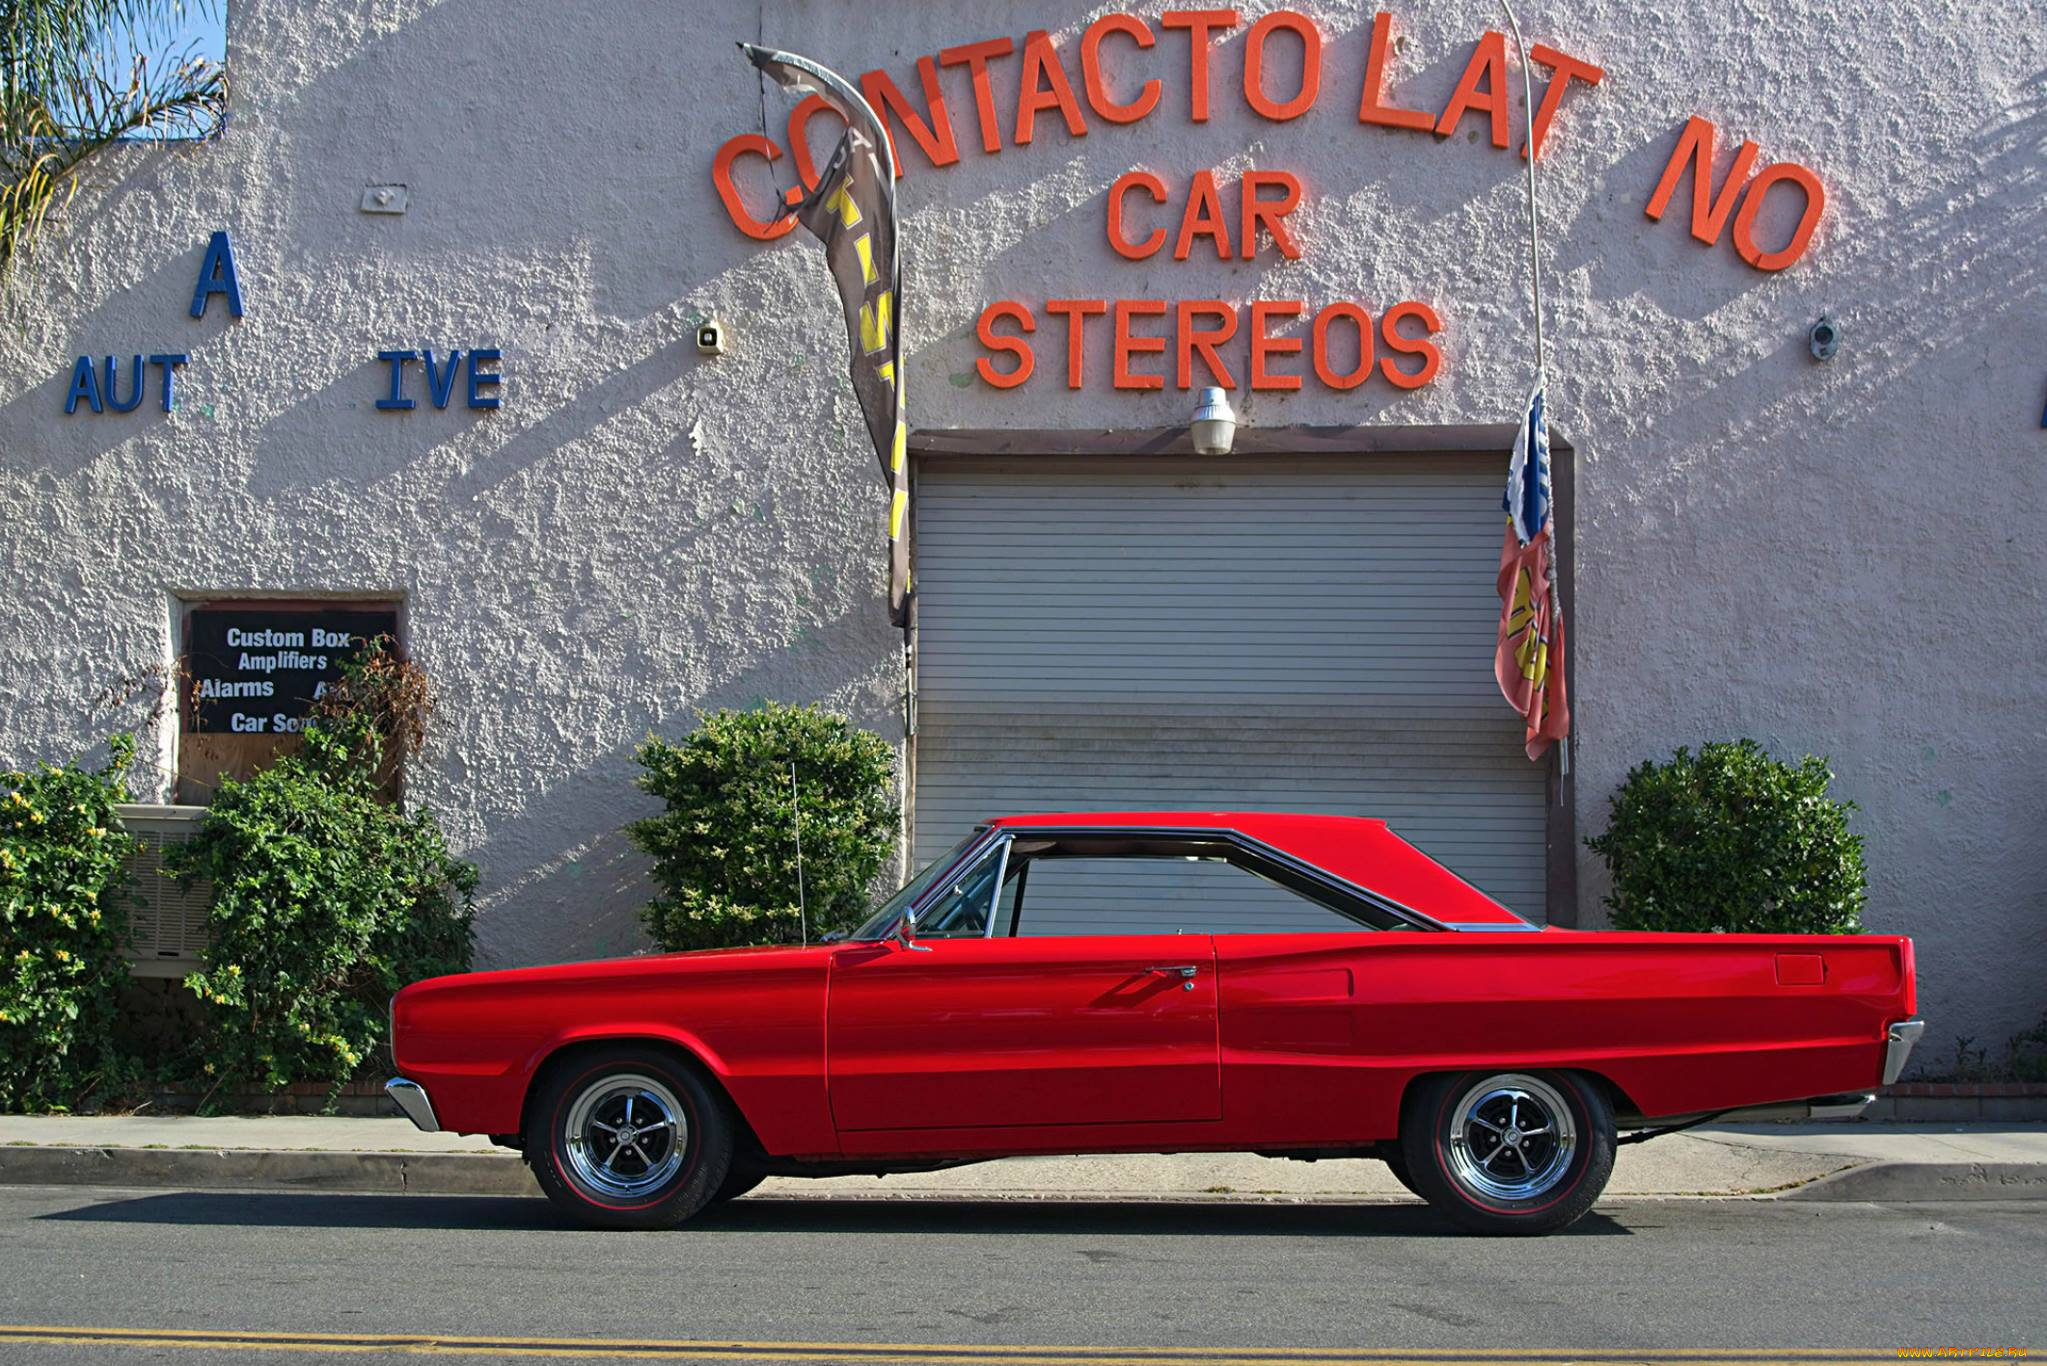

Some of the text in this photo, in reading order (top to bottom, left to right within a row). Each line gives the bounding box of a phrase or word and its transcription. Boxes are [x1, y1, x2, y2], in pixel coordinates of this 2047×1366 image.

[713, 10, 1322, 241] CONTACTO
[1359, 13, 1604, 161] LAT
[1645, 115, 1826, 271] NO
[1106, 170, 1302, 262] CAR
[188, 230, 243, 318] A
[975, 300, 1441, 391] STEREOS
[64, 349, 502, 414] AUT IVE
[227, 628, 350, 648] Custom Box
[238, 651, 328, 674] Amplifiers
[199, 678, 274, 699] Alarms
[231, 712, 268, 733] Car
